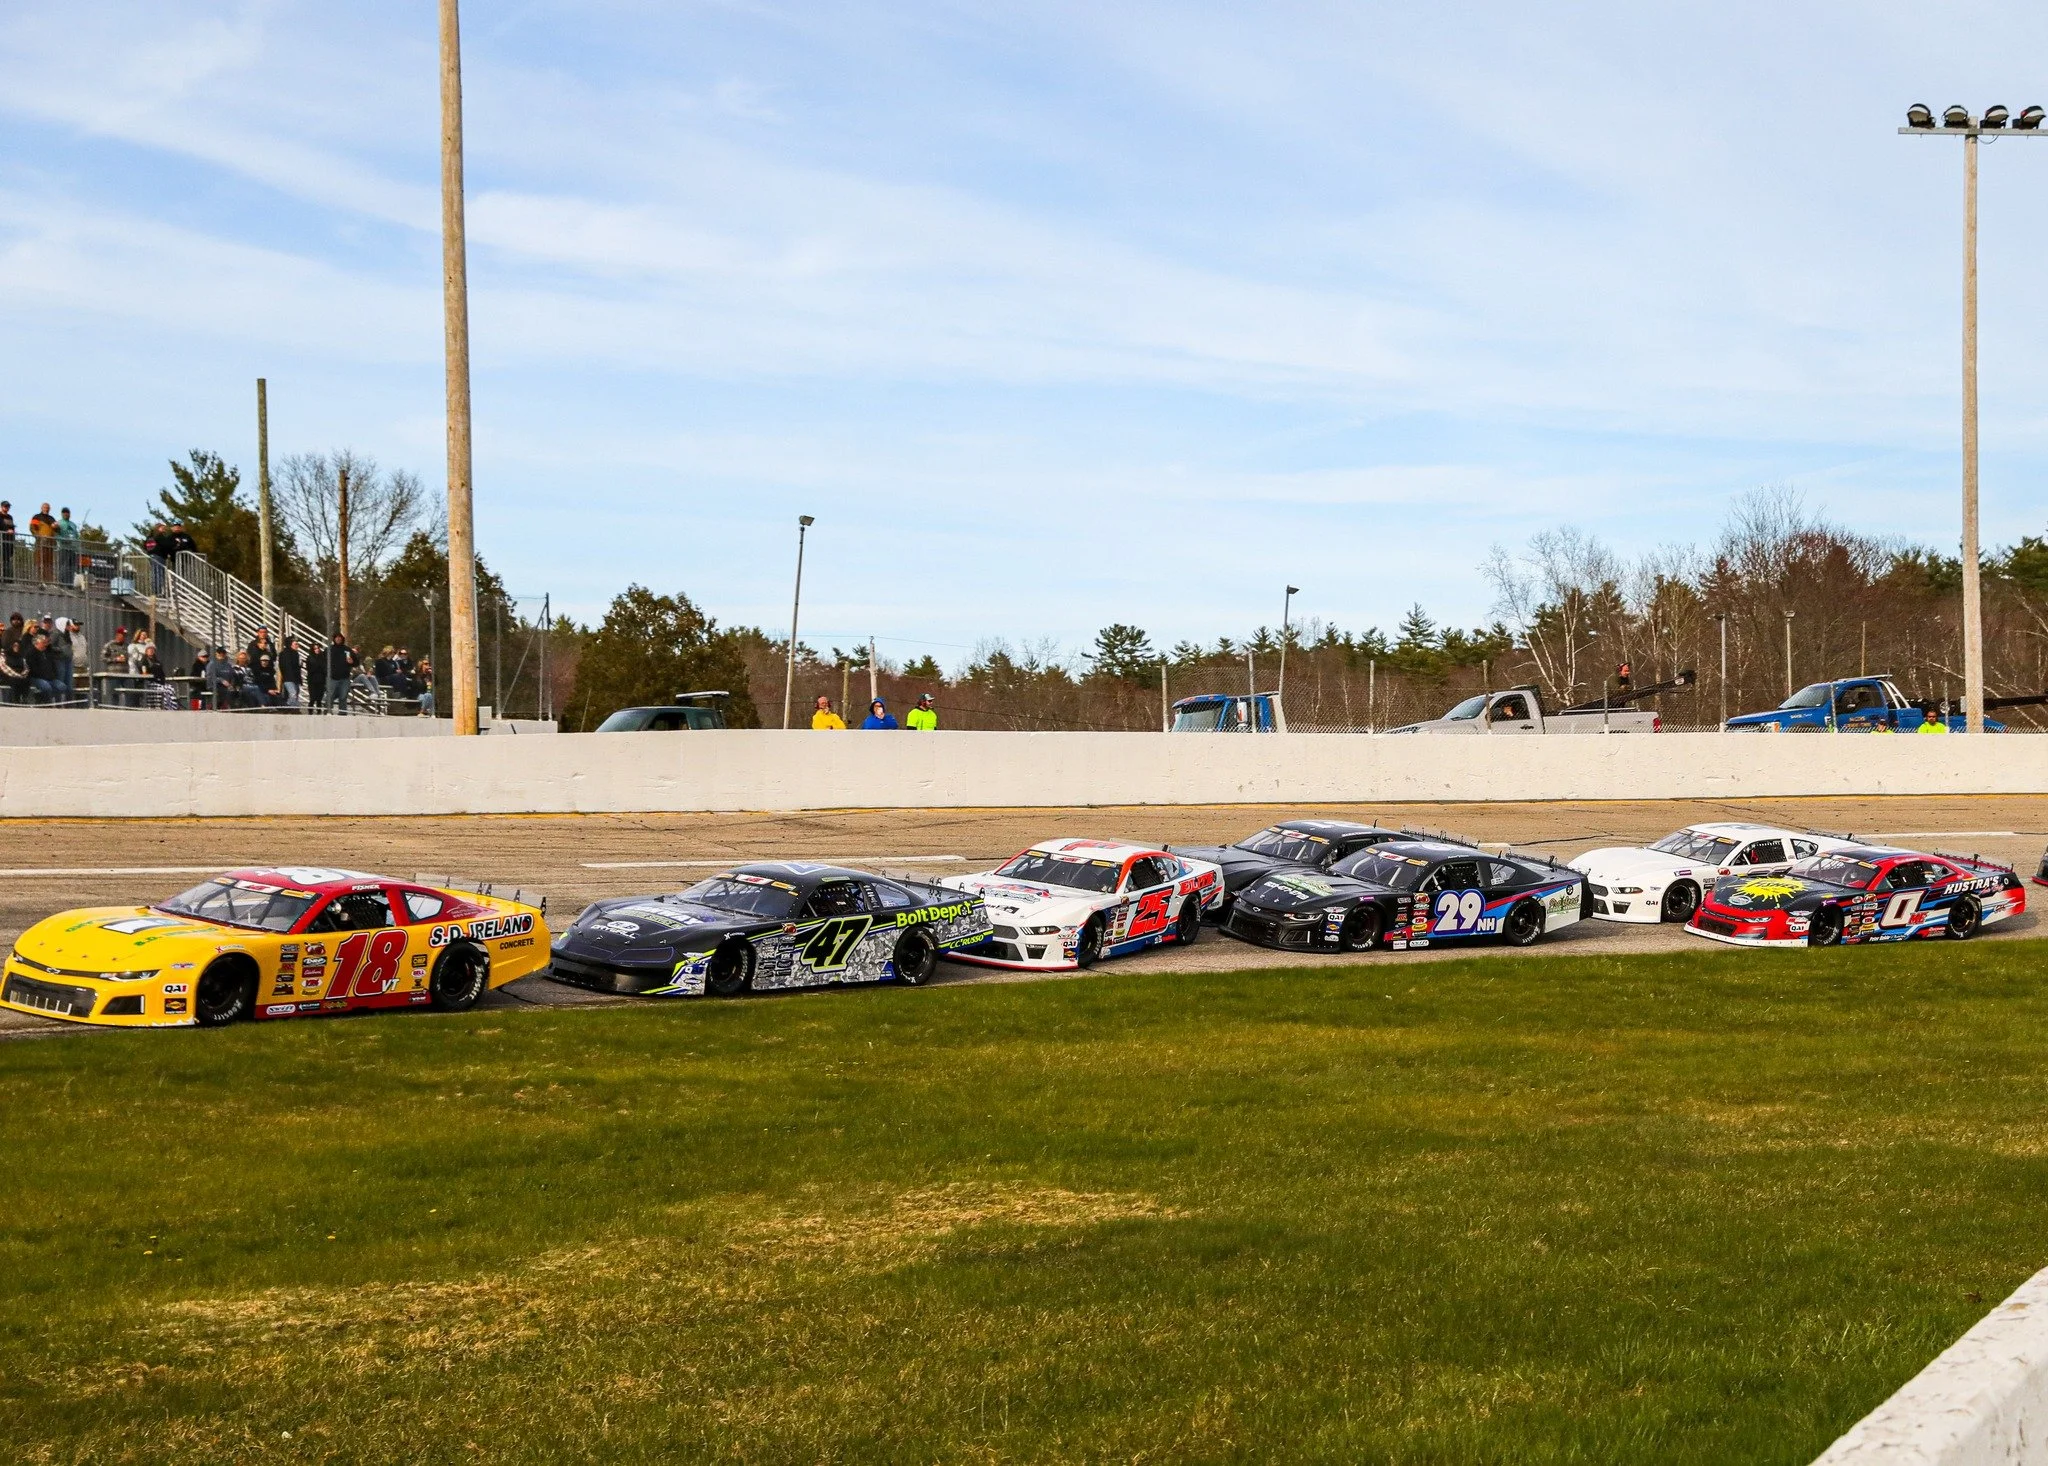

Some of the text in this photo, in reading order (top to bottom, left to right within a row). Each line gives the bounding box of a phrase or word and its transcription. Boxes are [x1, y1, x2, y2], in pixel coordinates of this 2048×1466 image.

[469, 914, 534, 941] IRELAND
[896, 908, 928, 928] Bolt
[1128, 888, 1174, 938] 25
[1433, 890, 1484, 932] 29
[1477, 918, 1495, 931] NH
[1881, 889, 1925, 928] 0
[499, 938, 535, 951] CONCRETE
[800, 914, 873, 973] 47
[325, 929, 408, 1000] 18
[382, 979, 399, 992] VT
[164, 985, 187, 993] QA1
